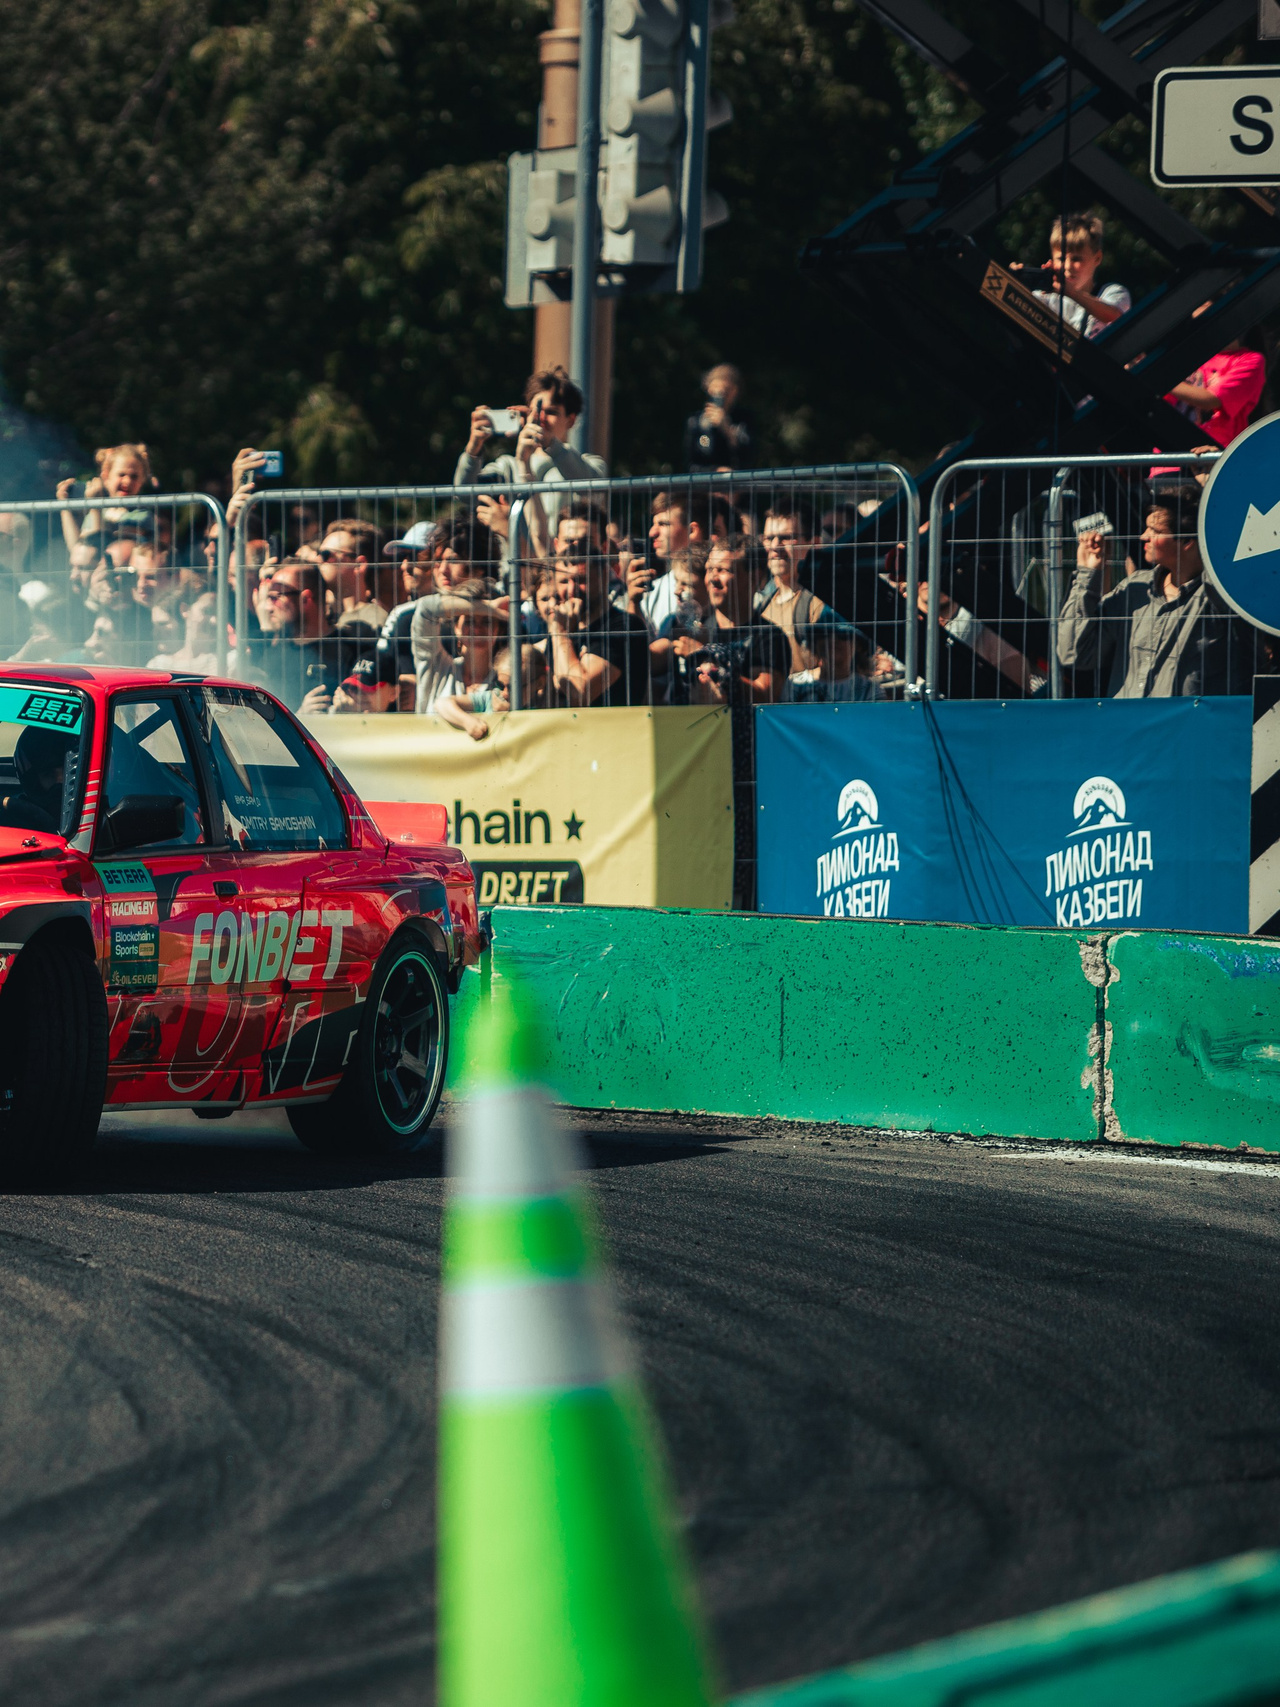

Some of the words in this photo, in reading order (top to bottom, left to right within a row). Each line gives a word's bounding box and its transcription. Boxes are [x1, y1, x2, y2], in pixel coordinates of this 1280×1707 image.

[30, 697, 80, 714] BET
[240, 815, 268, 831] DMITRY
[269, 815, 316, 831] SAMOSHKIN
[816, 832, 900, 898] ЛИМОНАД
[1045, 830, 1153, 898] ЛИМОНАД
[479, 871, 569, 903] DRIFT
[823, 879, 891, 918] КАЗБЕГИ
[1056, 878, 1143, 927] КАЗБЕГИ
[115, 930, 151, 943] Blockchain
[115, 944, 139, 957] Sports
[186, 909, 354, 986] FONBET
[132, 973, 157, 984] SEVEN
